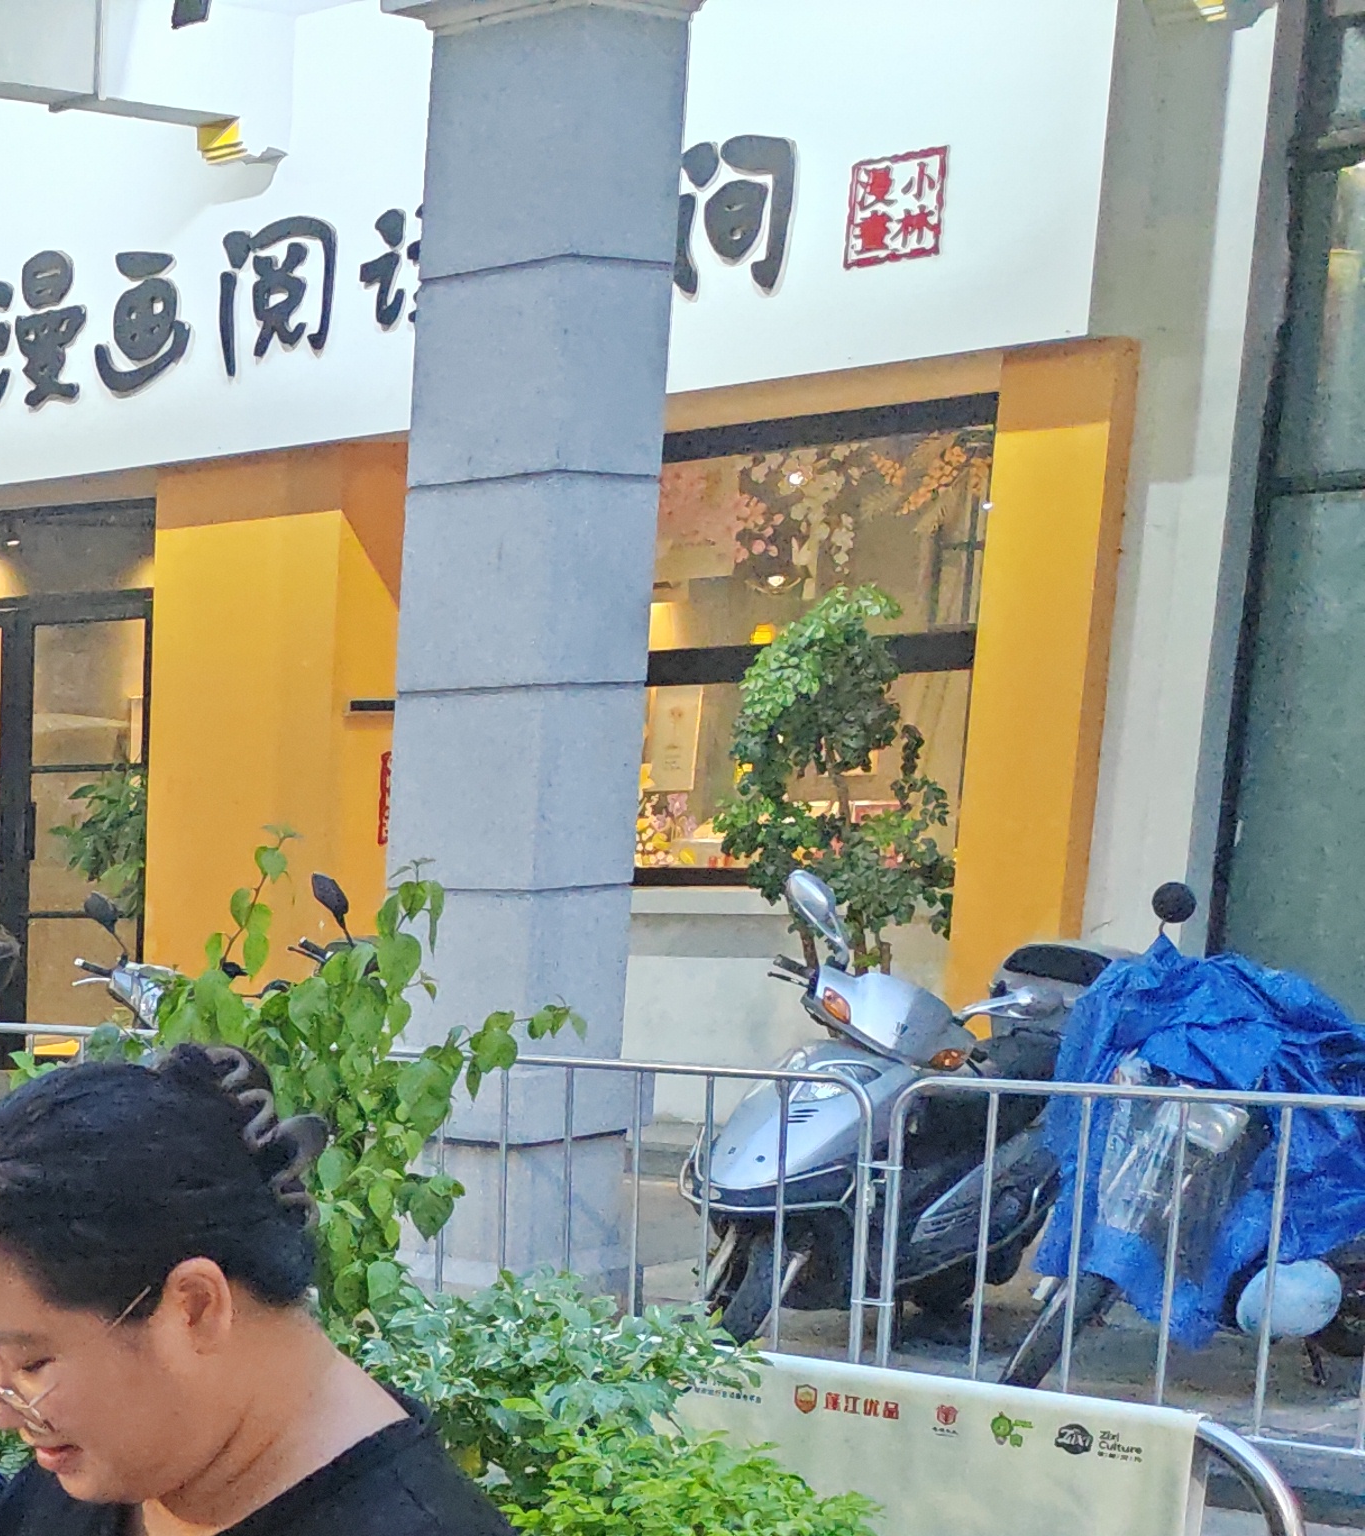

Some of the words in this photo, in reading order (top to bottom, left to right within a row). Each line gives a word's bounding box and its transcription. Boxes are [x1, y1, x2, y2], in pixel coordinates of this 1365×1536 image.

[823, 1391, 900, 1420] 蓬江优品
[1098, 1441, 1143, 1455] Culture
